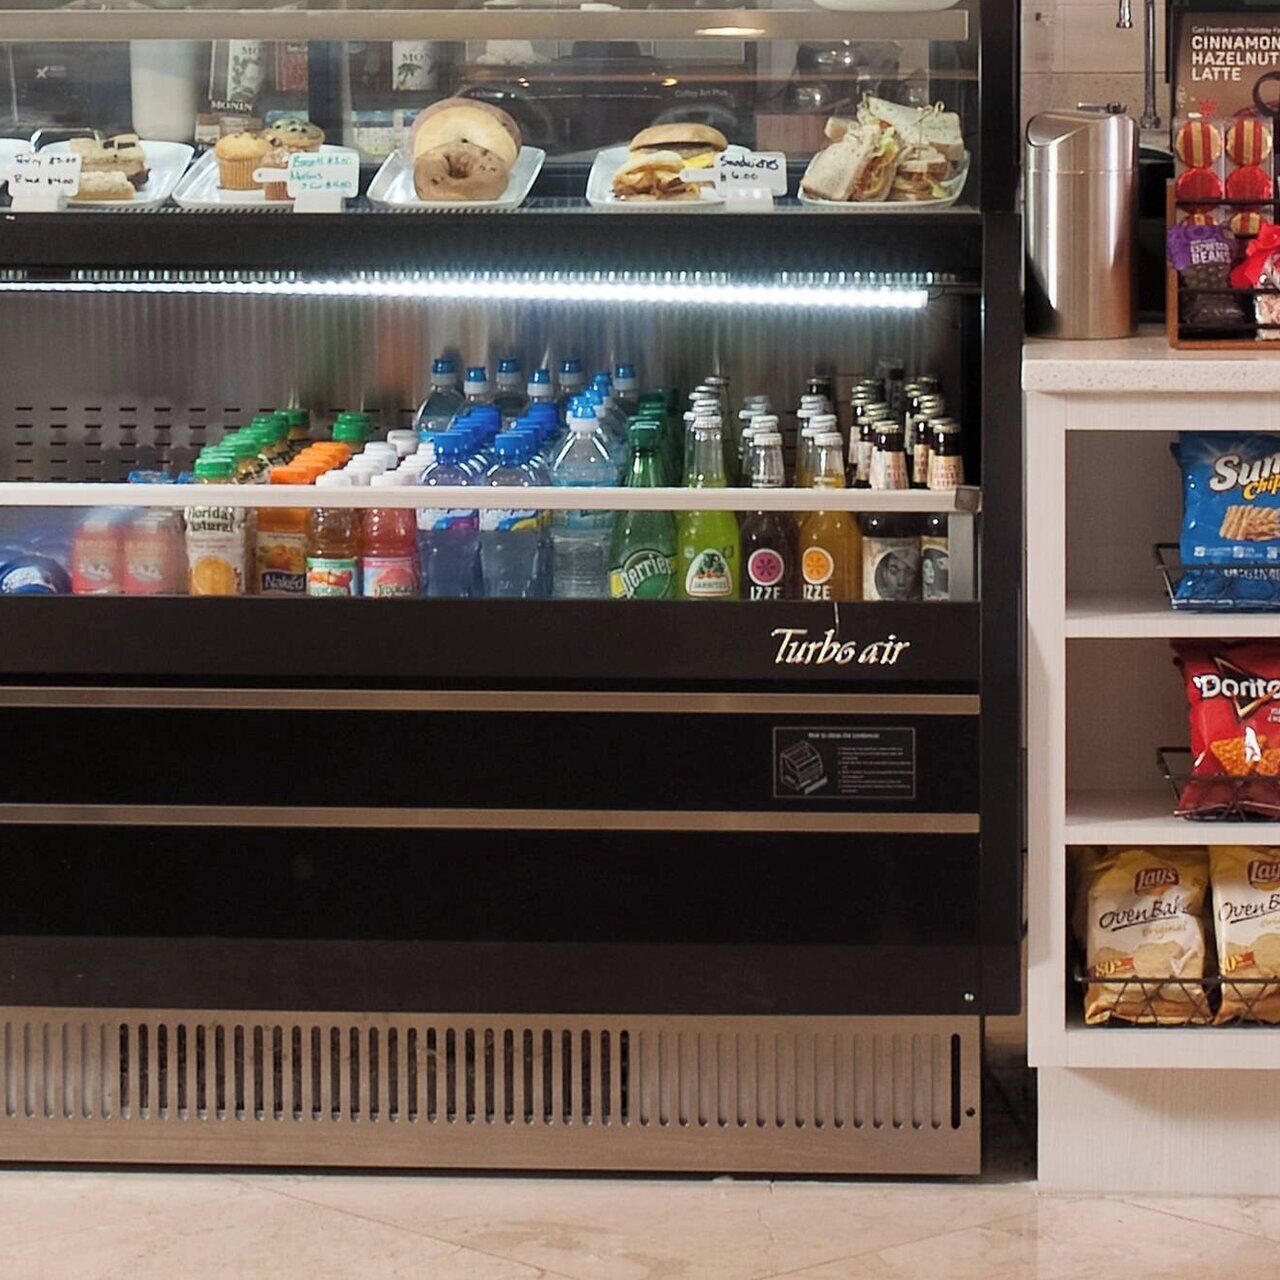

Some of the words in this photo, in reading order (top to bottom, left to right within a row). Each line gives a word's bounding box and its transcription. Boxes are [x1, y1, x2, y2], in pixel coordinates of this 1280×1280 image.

[1191, 51, 1279, 66] HAZELNUT
[1191, 67, 1241, 81] LATTE
[265, 573, 305, 590] Naked
[802, 584, 830, 600] IZZE
[771, 628, 856, 665] Turbo
[858, 634, 910, 665] air
[1100, 907, 1149, 928] Oven
[1221, 898, 1267, 922] Oven
